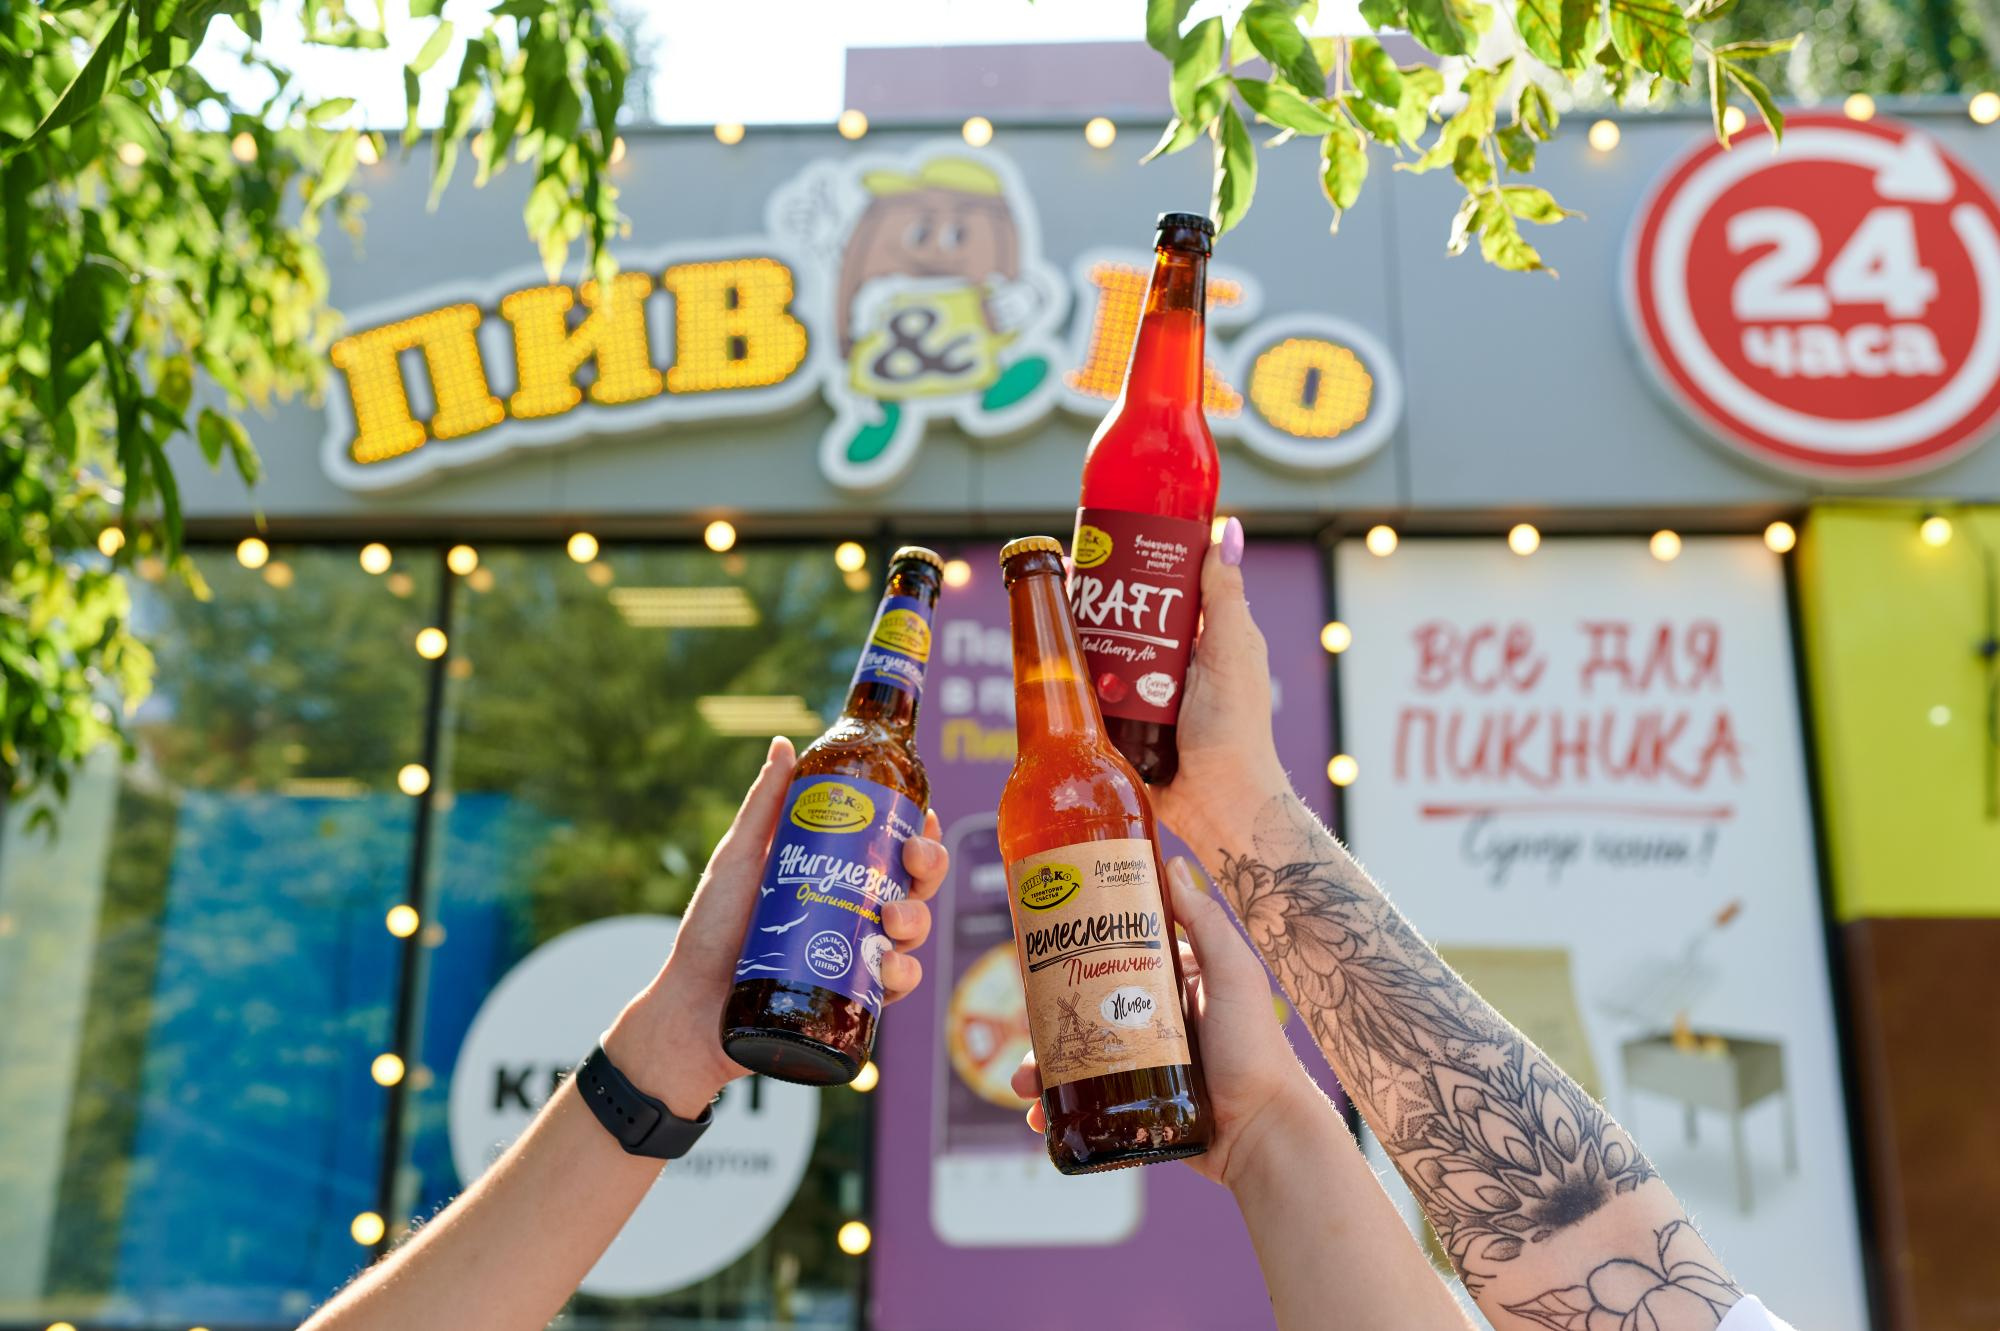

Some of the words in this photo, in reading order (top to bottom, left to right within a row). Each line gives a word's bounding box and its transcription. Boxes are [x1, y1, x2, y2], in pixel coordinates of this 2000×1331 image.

[1725, 206, 1939, 321] 24
[331, 258, 807, 464] ПИВ
[1740, 322, 1947, 378] часа
[1069, 575, 1184, 633] CRAFT
[1099, 639, 1136, 663] Cherry
[1134, 644, 1156, 661] Ale
[1577, 617, 1724, 694] ДЛЯ
[1394, 705, 1747, 791] ПИКНИКА
[796, 884, 881, 925] Оригинальное
[1031, 885, 1064, 899] ТЕРРИТОРИЯ
[1035, 892, 1059, 903] СЧАСТЬЯ
[815, 960, 839, 973] ПИВО
[1062, 955, 1163, 987] Пшеничное
[1112, 993, 1152, 1020] Живое
